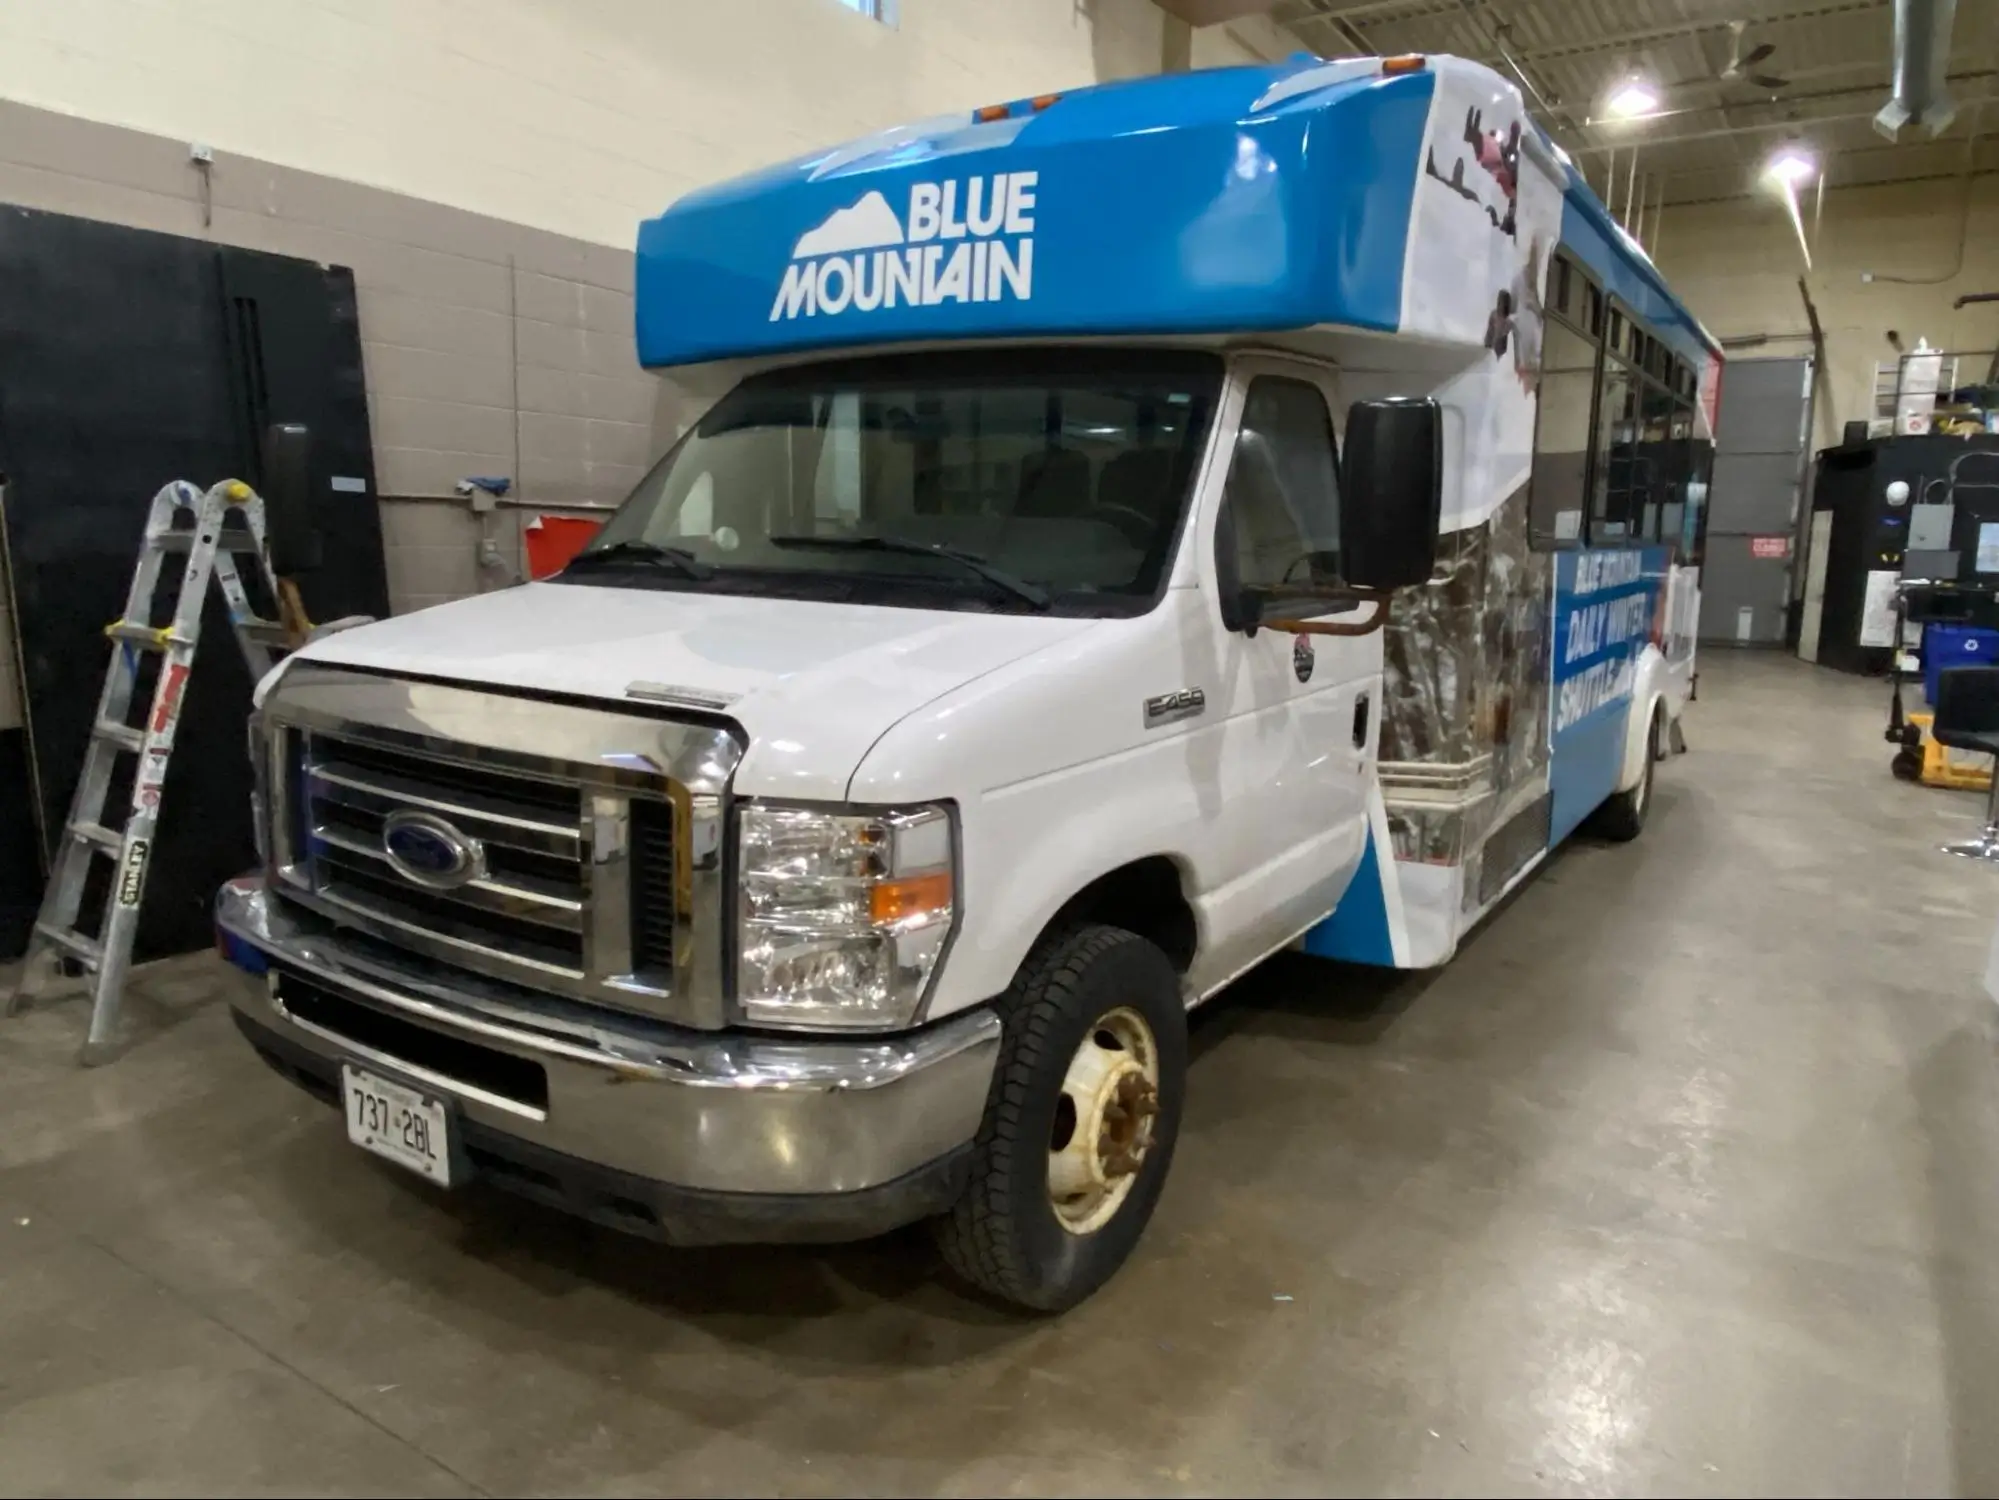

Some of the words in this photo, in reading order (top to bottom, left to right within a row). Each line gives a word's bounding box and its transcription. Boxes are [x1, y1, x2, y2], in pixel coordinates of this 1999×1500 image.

[908, 171, 1038, 242] BLUE
[769, 238, 1034, 322] MOUNTAIN
[1565, 602, 1608, 664] DAILY
[121, 842, 148, 903] STANLEY
